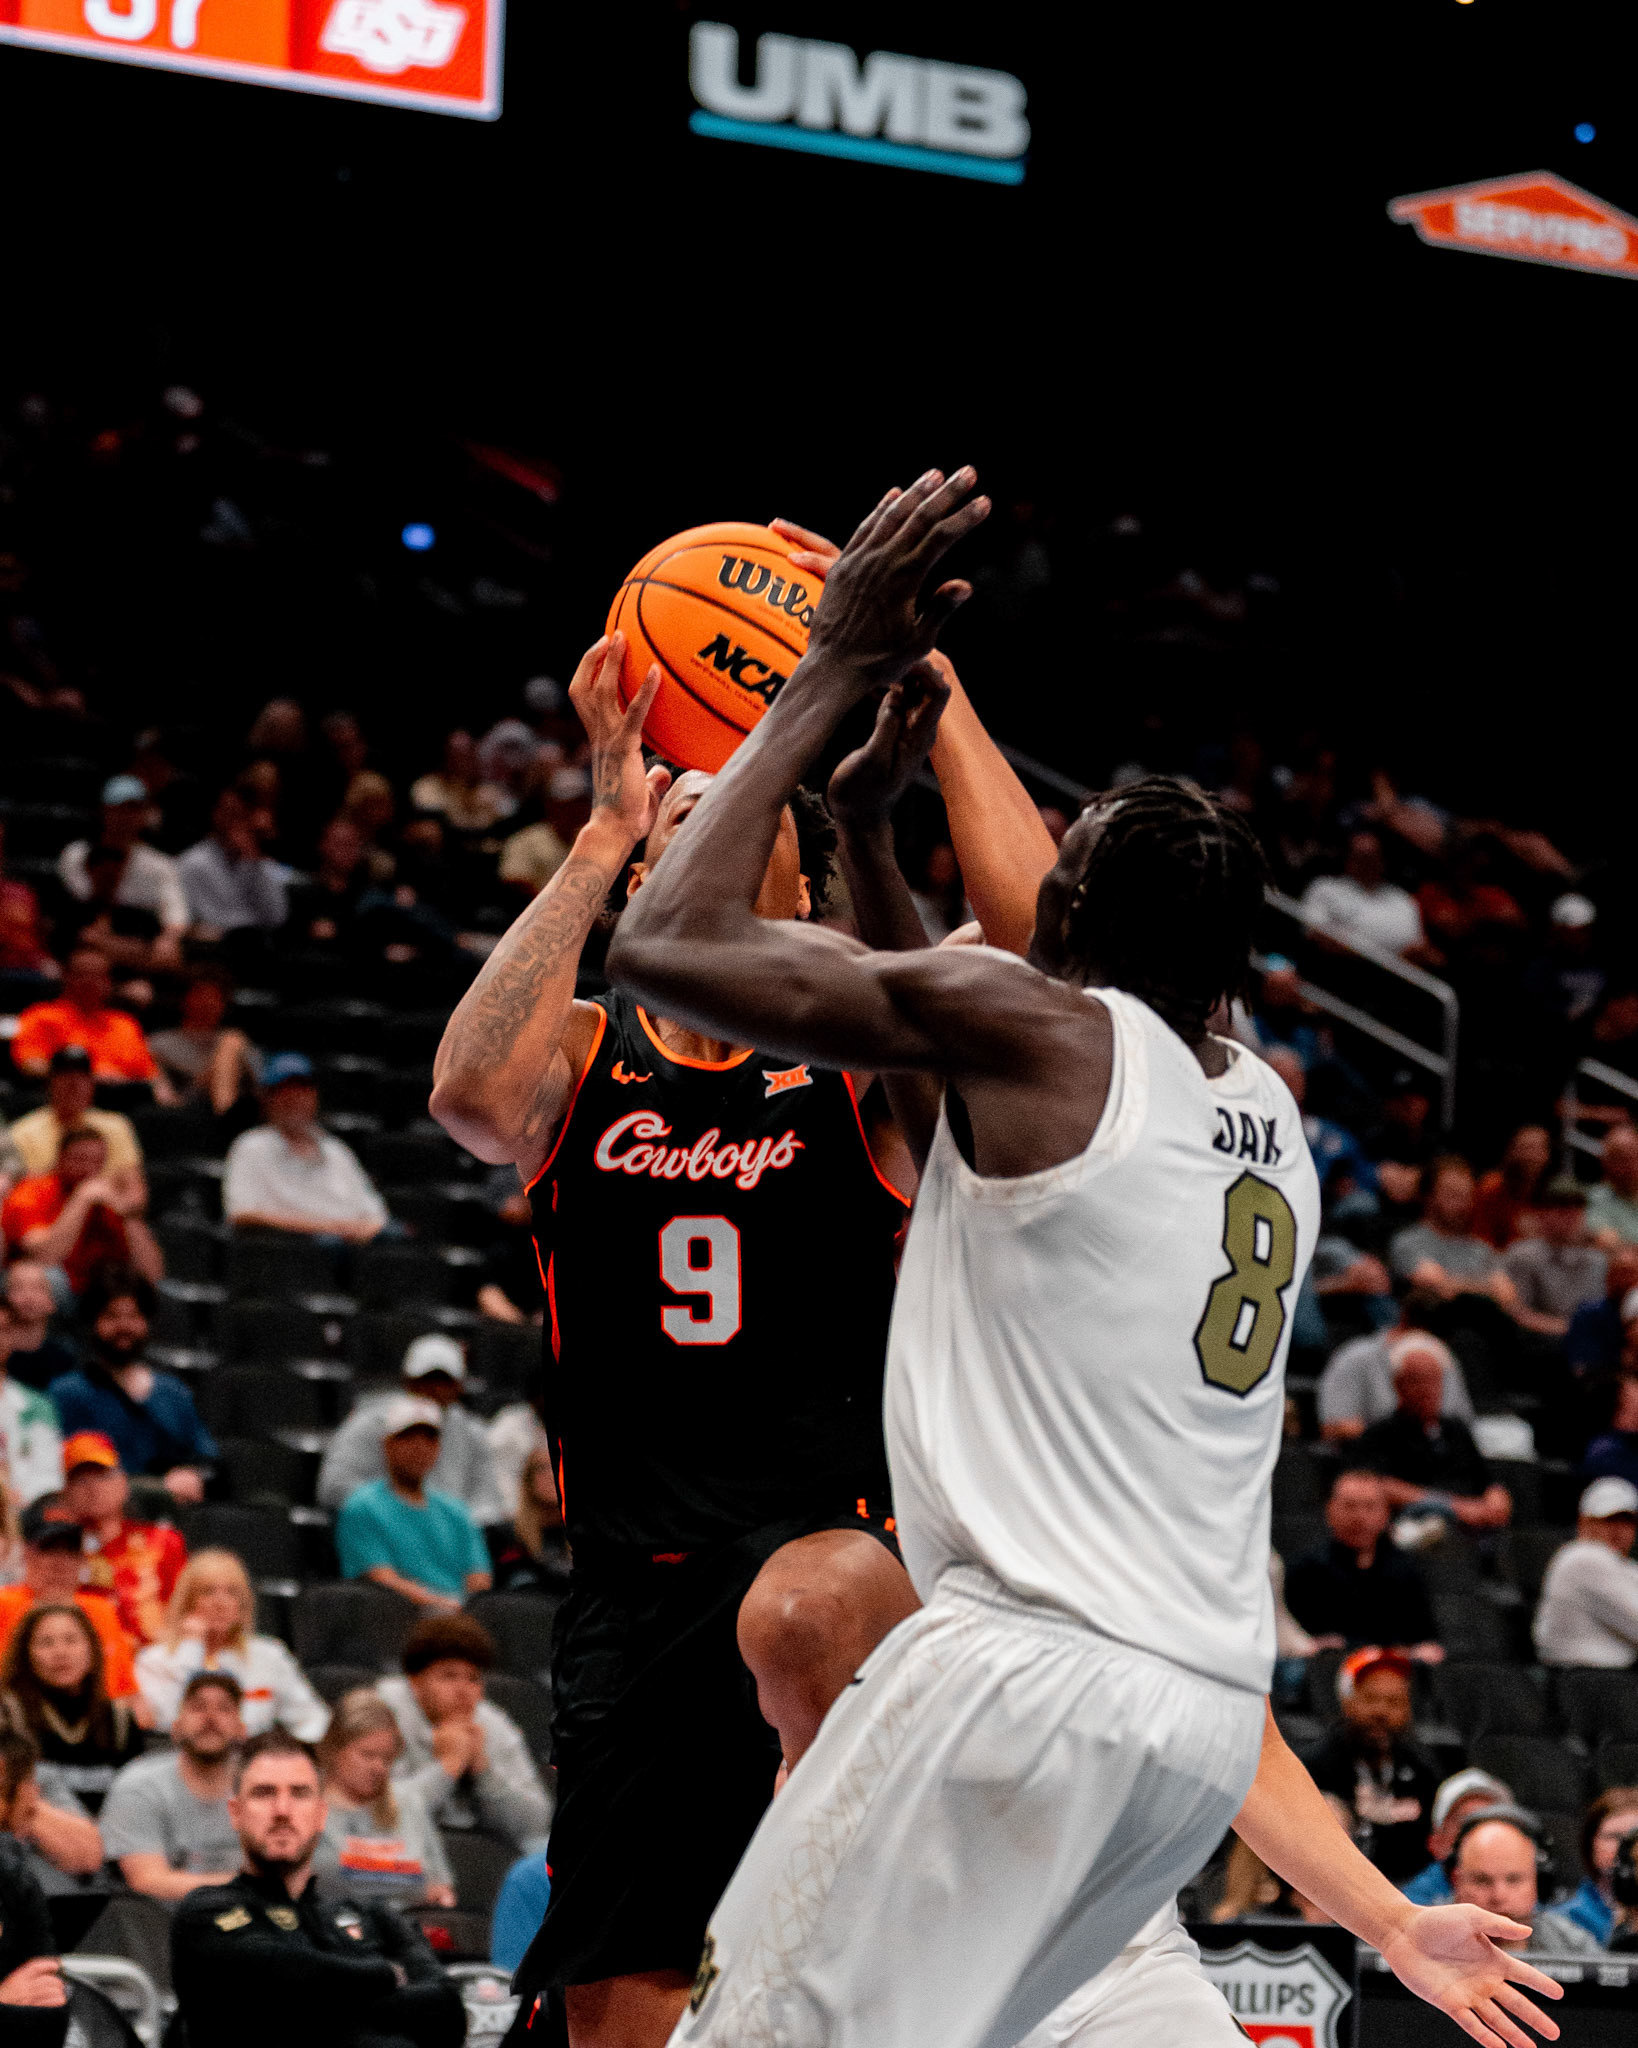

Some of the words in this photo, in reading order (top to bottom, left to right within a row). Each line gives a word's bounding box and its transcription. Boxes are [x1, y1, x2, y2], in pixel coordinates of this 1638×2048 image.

[688, 20, 1031, 160] UMB
[594, 1110, 806, 1190] Cowboys
[658, 1215, 742, 1346] 9
[1193, 1169, 1298, 1398] 8
[1212, 1982, 1315, 2016] ILLIPS
